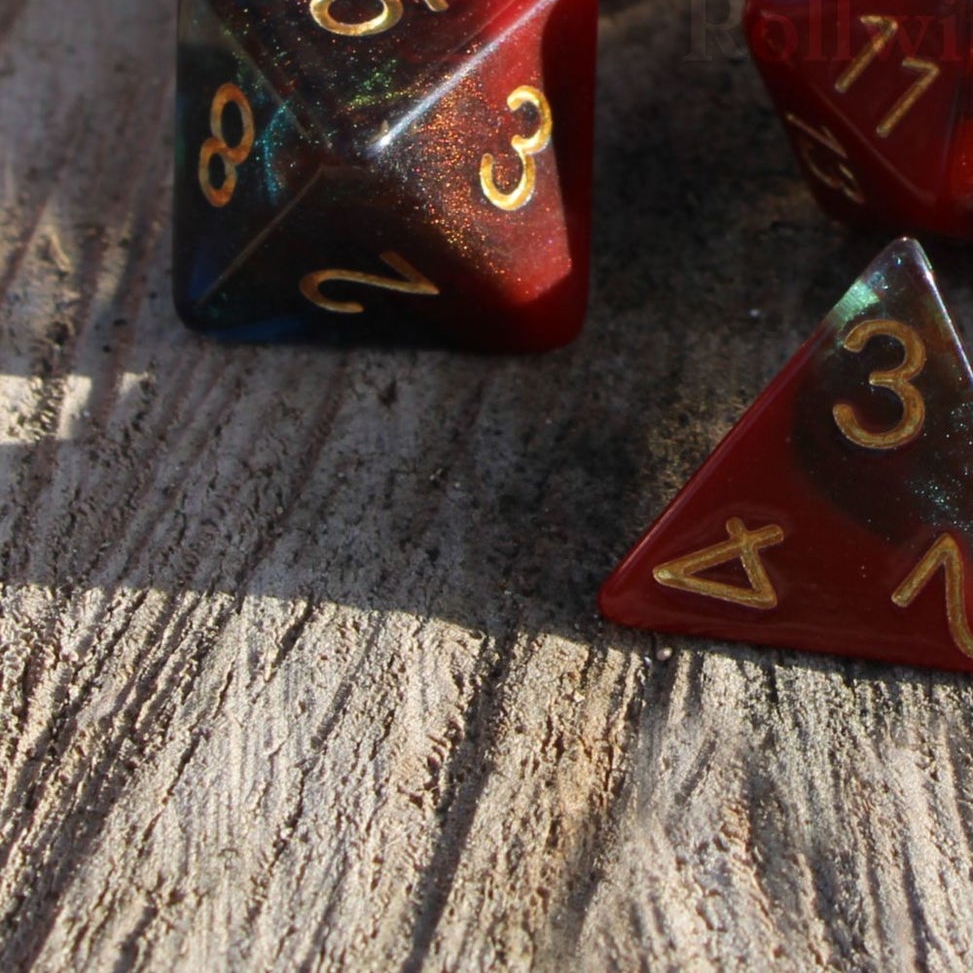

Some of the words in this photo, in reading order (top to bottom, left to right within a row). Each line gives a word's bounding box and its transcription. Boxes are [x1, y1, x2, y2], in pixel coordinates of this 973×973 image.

[198, 82, 255, 208] 8
[479, 84, 553, 211] 3
[300, 250, 440, 314] 2
[833, 319, 927, 450] 3
[652, 516, 784, 610] 4
